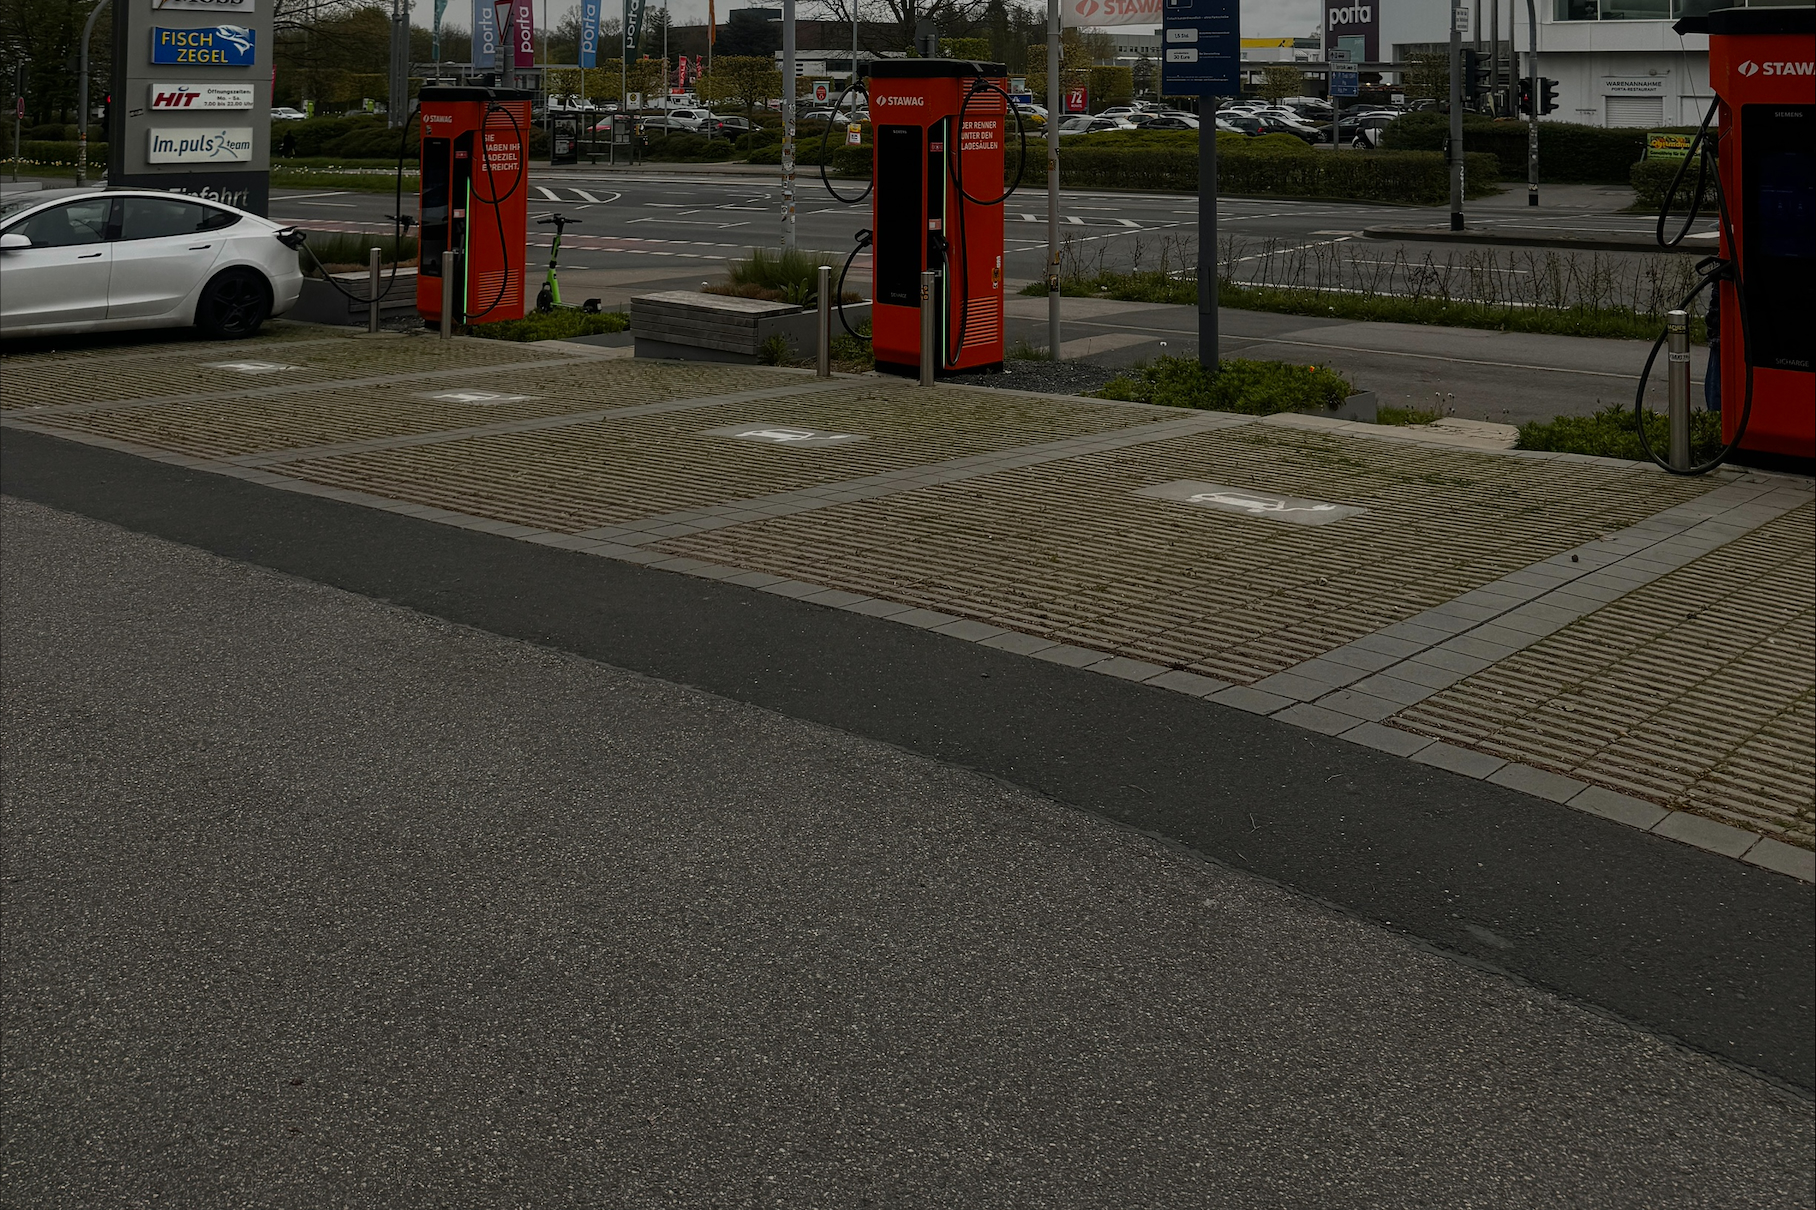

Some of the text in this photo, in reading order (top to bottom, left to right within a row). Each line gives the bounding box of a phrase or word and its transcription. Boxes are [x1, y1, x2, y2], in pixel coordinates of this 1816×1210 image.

[1329, 0, 1372, 32] porta
[482, 7, 496, 54] porta
[516, 5, 534, 53] porta
[581, 3, 596, 54] porta
[161, 31, 213, 47] FISCH
[177, 48, 229, 64] ZEGEL
[1762, 61, 1815, 76] STAW
[153, 92, 201, 107] HIT
[887, 96, 925, 107] STAWAG
[1071, 90, 1082, 103] 72
[429, 114, 453, 124] STAWAG
[974, 121, 996, 130] RENNER
[981, 131, 993, 139] DEN
[153, 134, 250, 156] Im.puls team
[961, 140, 998, 151] LADESÄULEN
